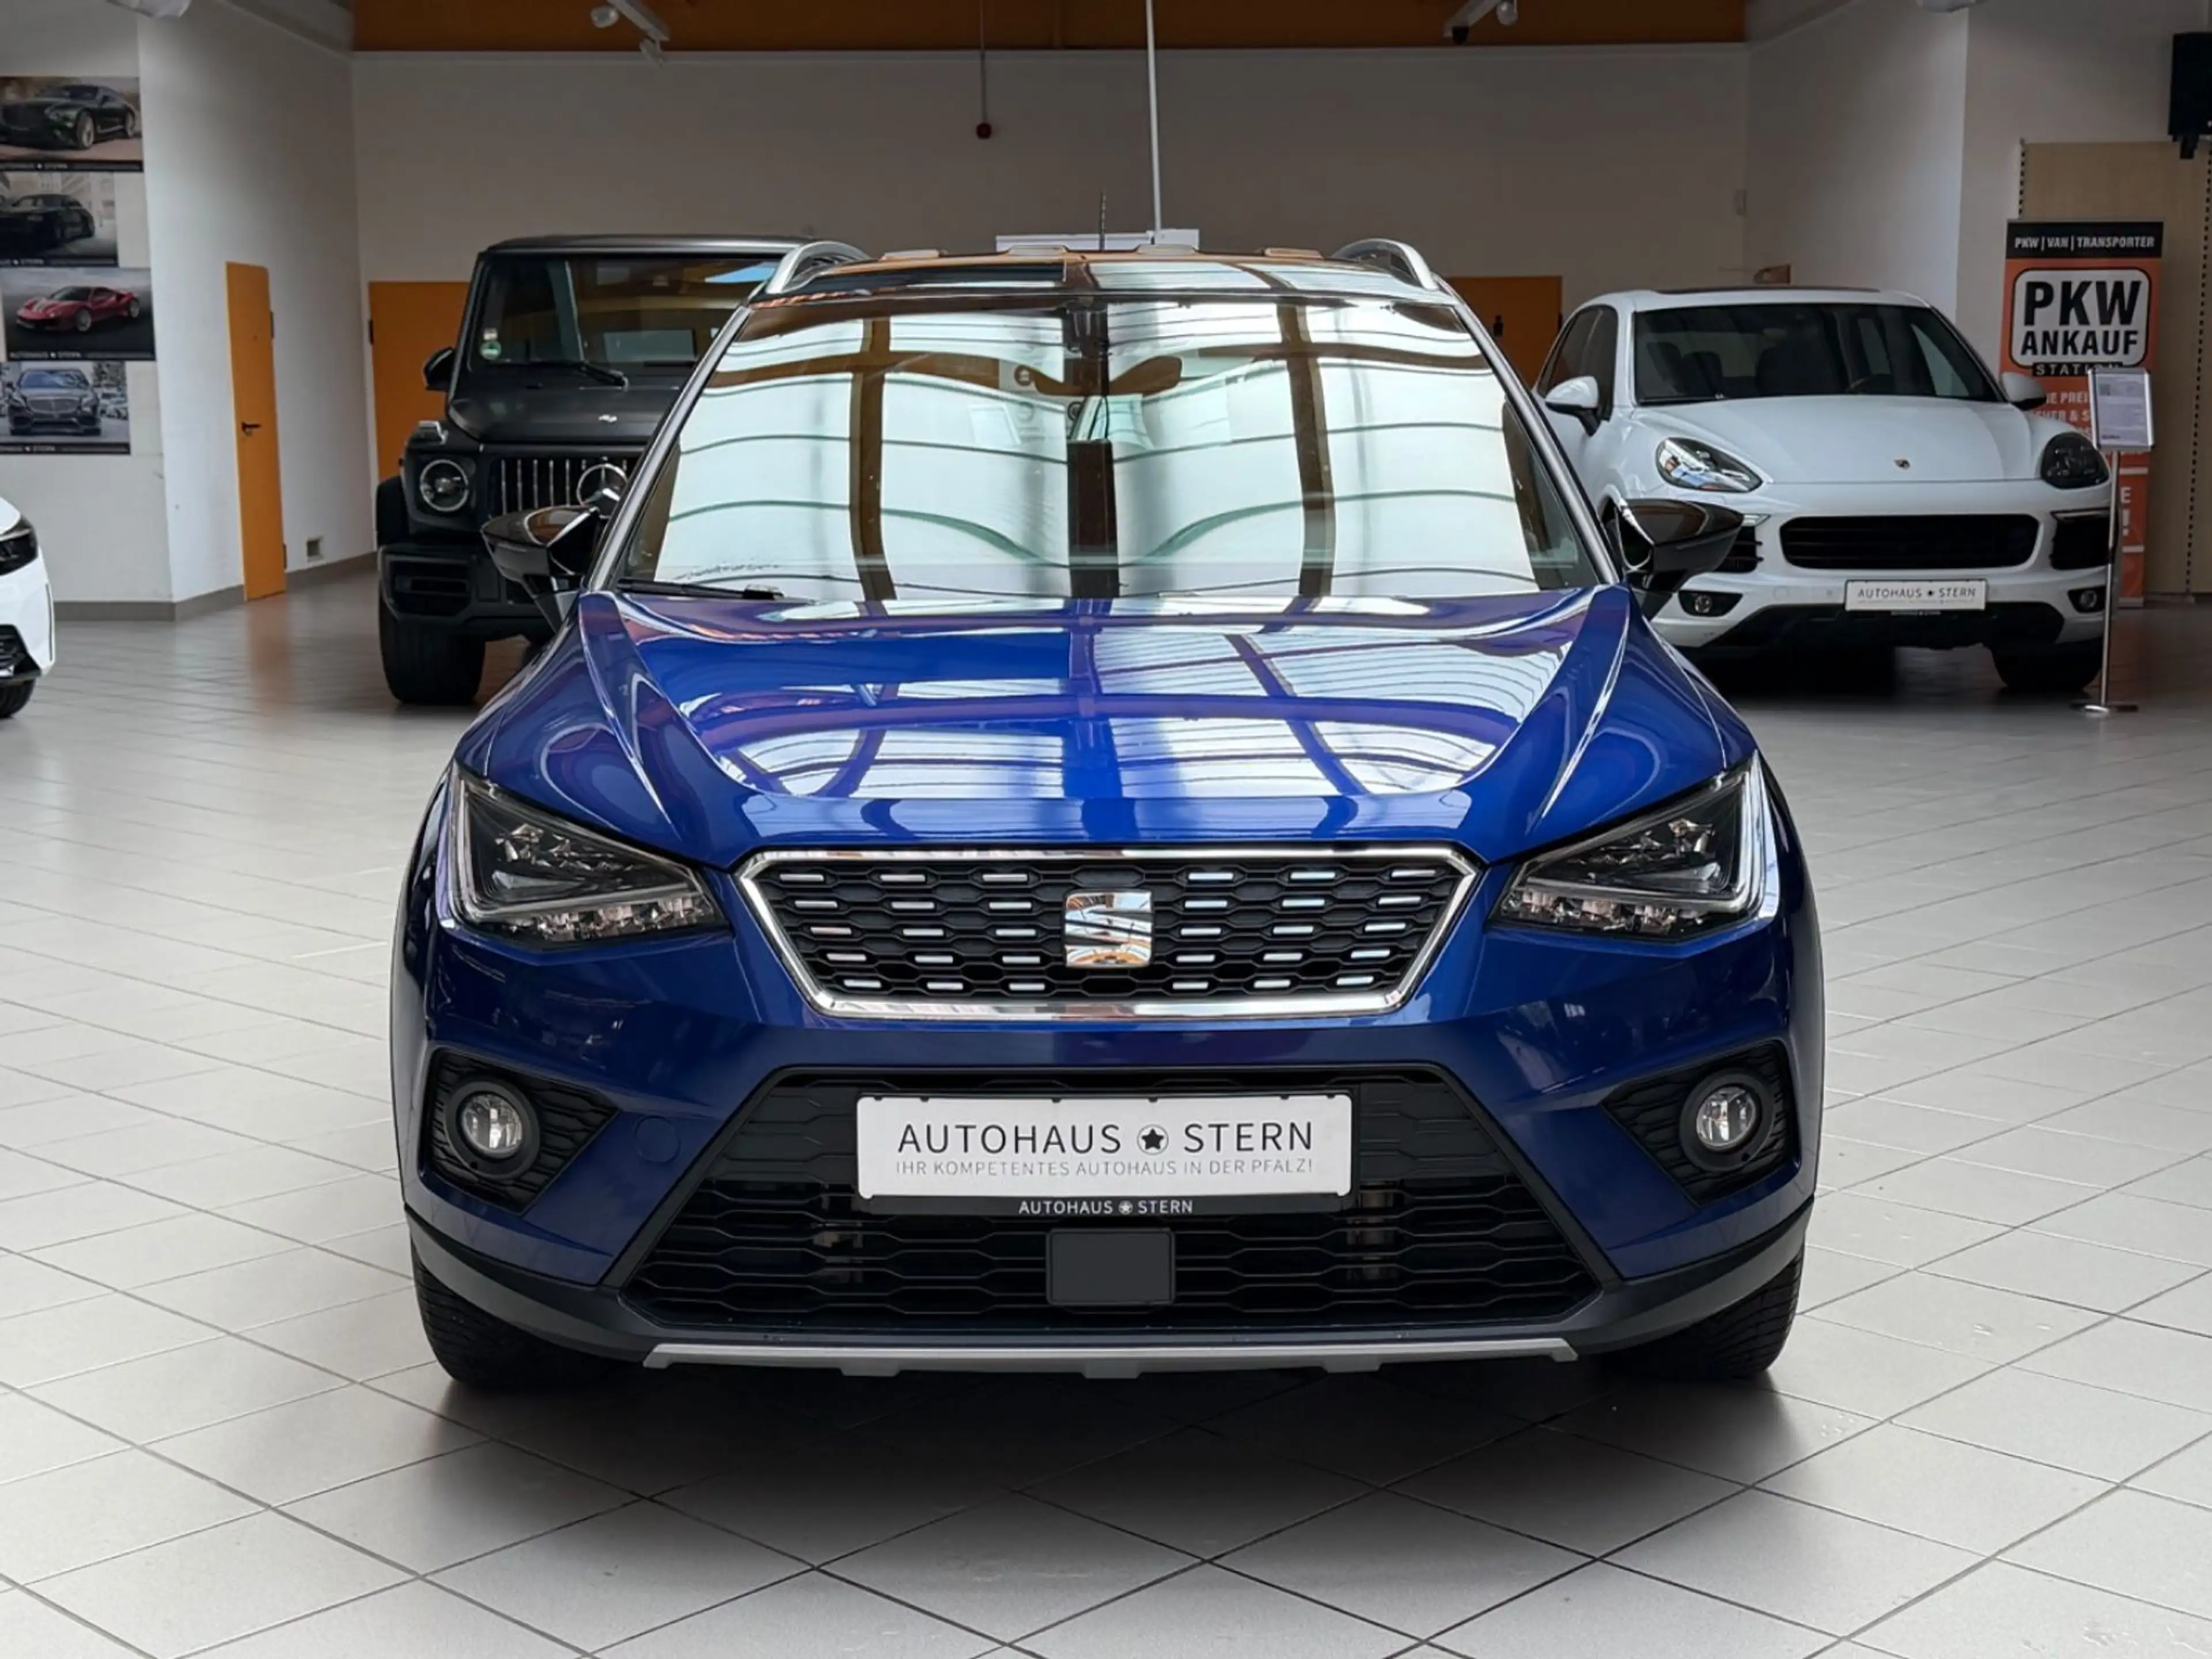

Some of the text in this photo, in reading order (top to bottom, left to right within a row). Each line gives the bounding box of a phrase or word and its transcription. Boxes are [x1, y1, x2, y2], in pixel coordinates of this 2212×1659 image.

[2014, 236, 2155, 248] PKW VAN TRANSPORTER
[2024, 281, 2142, 326] PKW
[2021, 330, 2139, 355] ANKAUF
[1857, 587, 1977, 599] AUTOHAUS STERN
[897, 1121, 1312, 1154] AUTOHAUS STERN
[896, 1158, 1313, 1176] IHR KOMPETENTES AUTOHAUS IN DER PFALZ!
[1018, 1200, 1194, 1215] AUTOHAUS STERN
